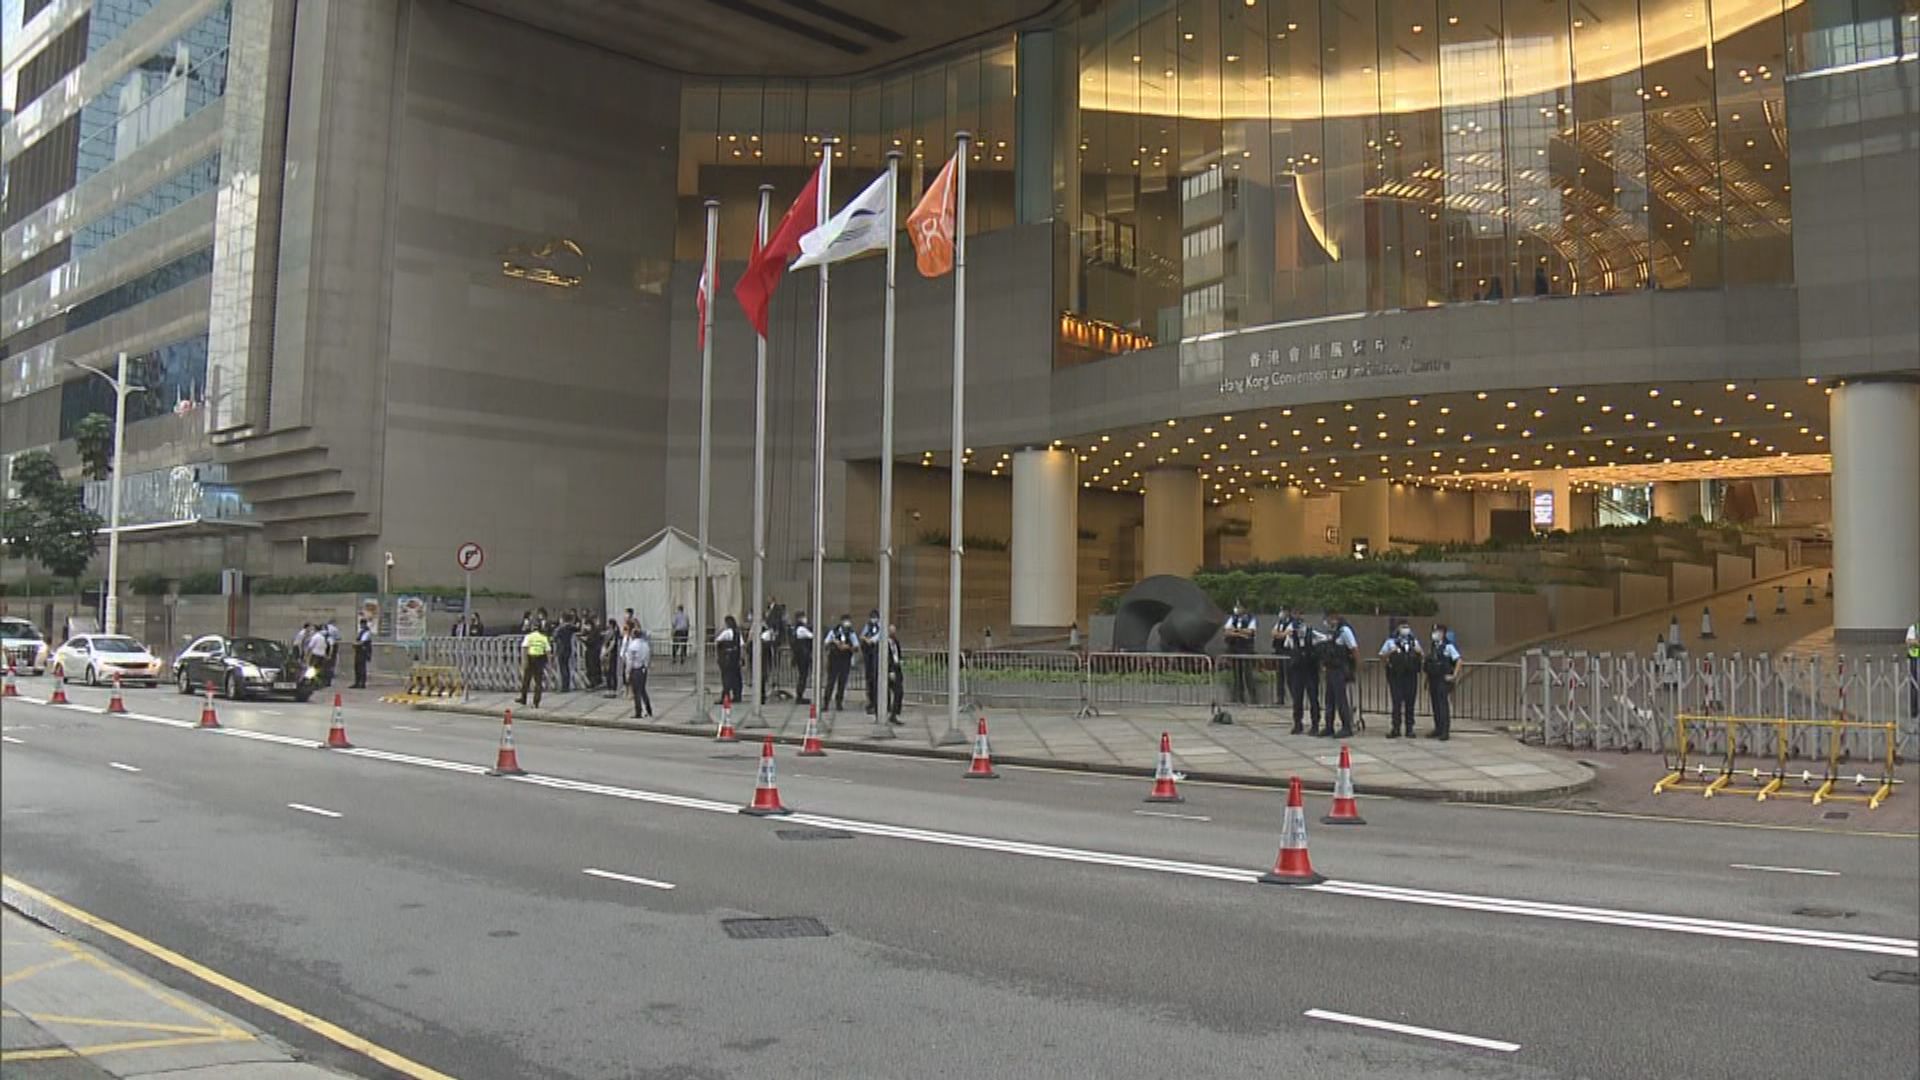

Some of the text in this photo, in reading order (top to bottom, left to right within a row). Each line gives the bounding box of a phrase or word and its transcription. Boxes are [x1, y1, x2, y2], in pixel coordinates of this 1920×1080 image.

[1219, 378, 1244, 393] Hong
[1246, 373, 1270, 391] Kong
[1271, 369, 1328, 385] Convention
